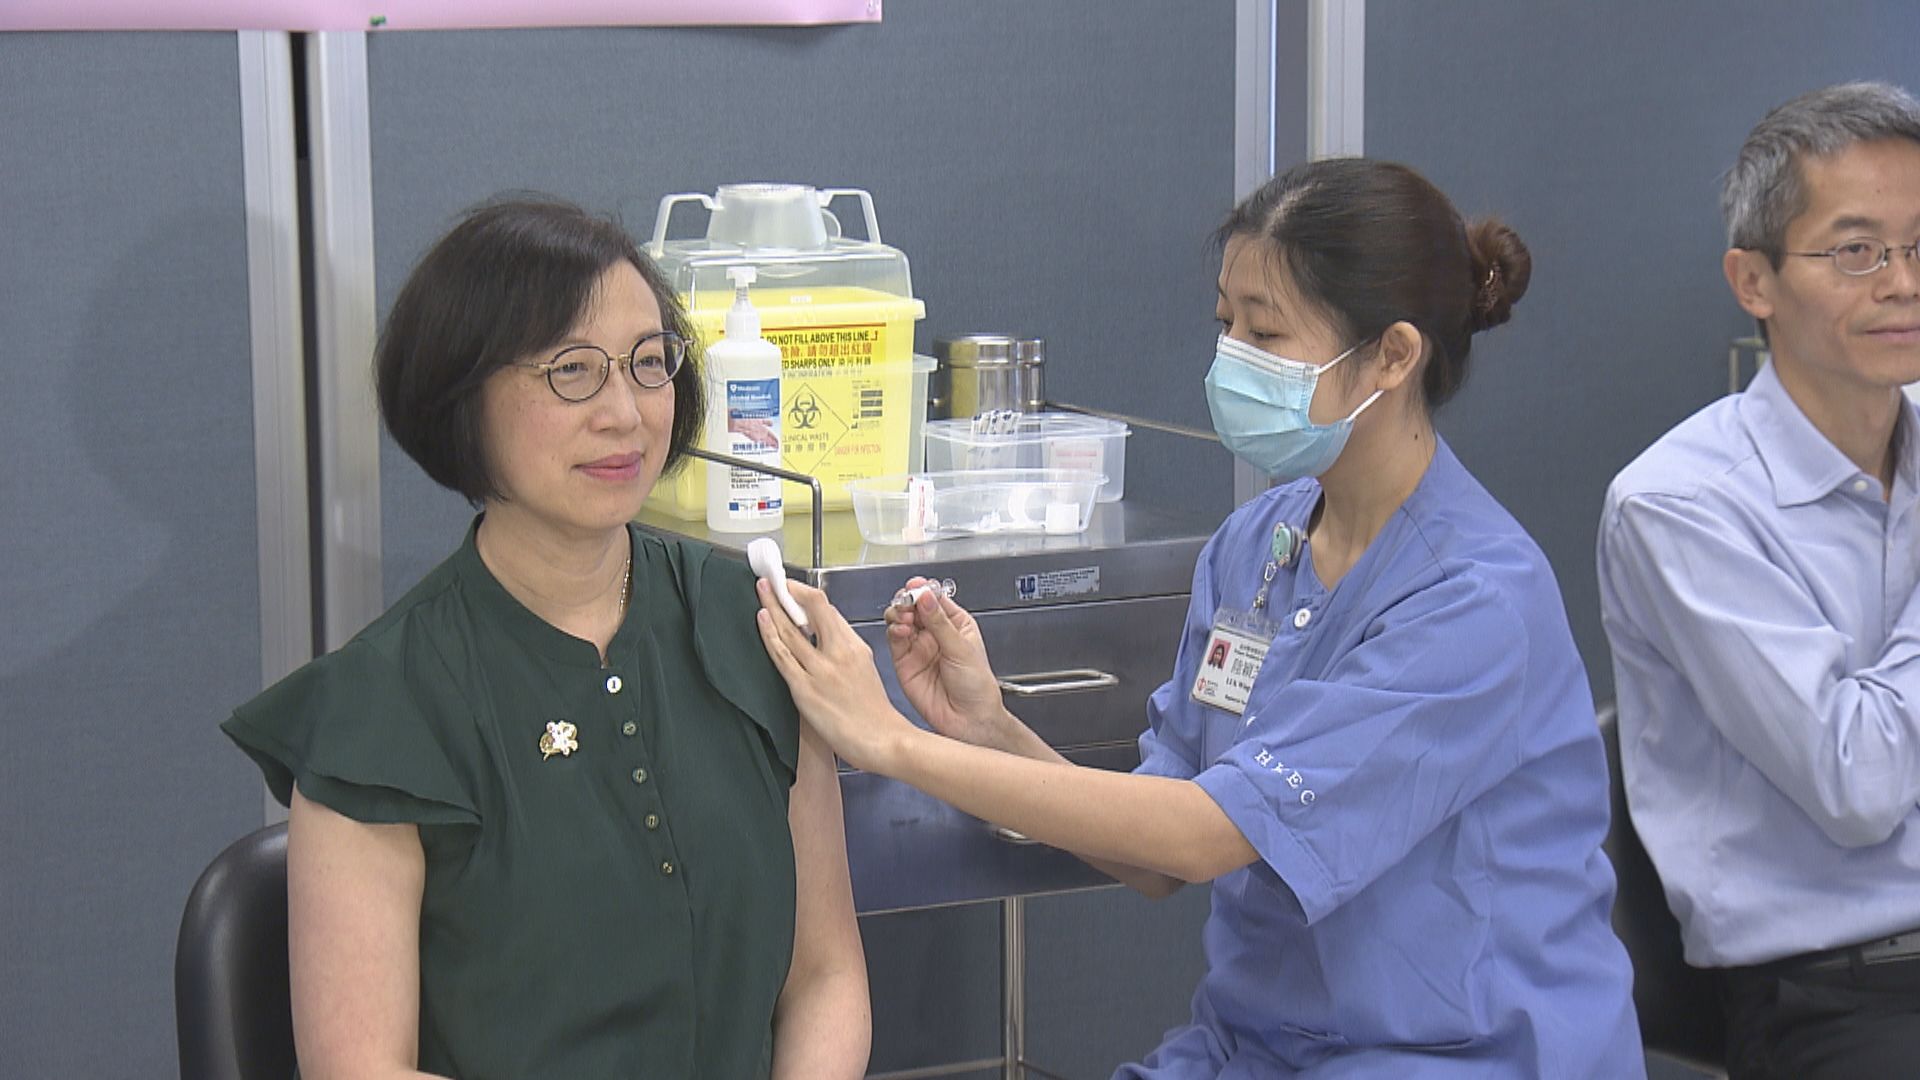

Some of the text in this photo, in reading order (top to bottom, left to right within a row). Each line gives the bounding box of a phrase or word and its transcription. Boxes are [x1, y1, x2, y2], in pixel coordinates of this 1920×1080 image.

[779, 335, 793, 345] NOT
[795, 334, 809, 344] FILL
[811, 333, 834, 343] ABOVE
[836, 332, 852, 342] THIS
[853, 330, 869, 341] LINE
[790, 358, 817, 369] SHARPS
[818, 357, 836, 368] ONLY
